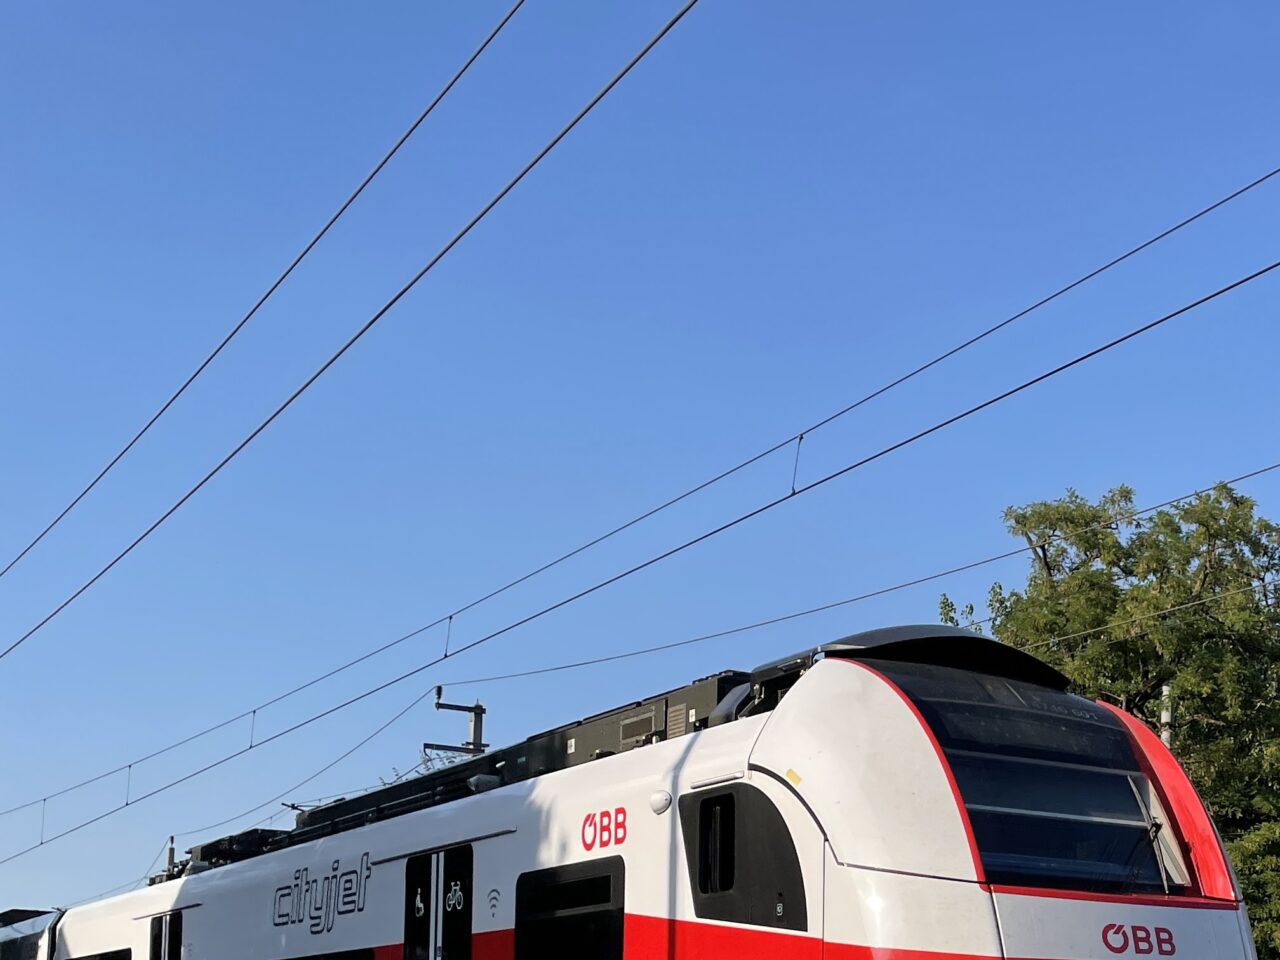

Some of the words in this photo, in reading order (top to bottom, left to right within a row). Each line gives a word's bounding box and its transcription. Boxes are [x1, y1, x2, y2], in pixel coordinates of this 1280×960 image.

[581, 807, 627, 851] ÖBB
[273, 852, 372, 935] cityjet
[1102, 923, 1176, 956] ÖBB
